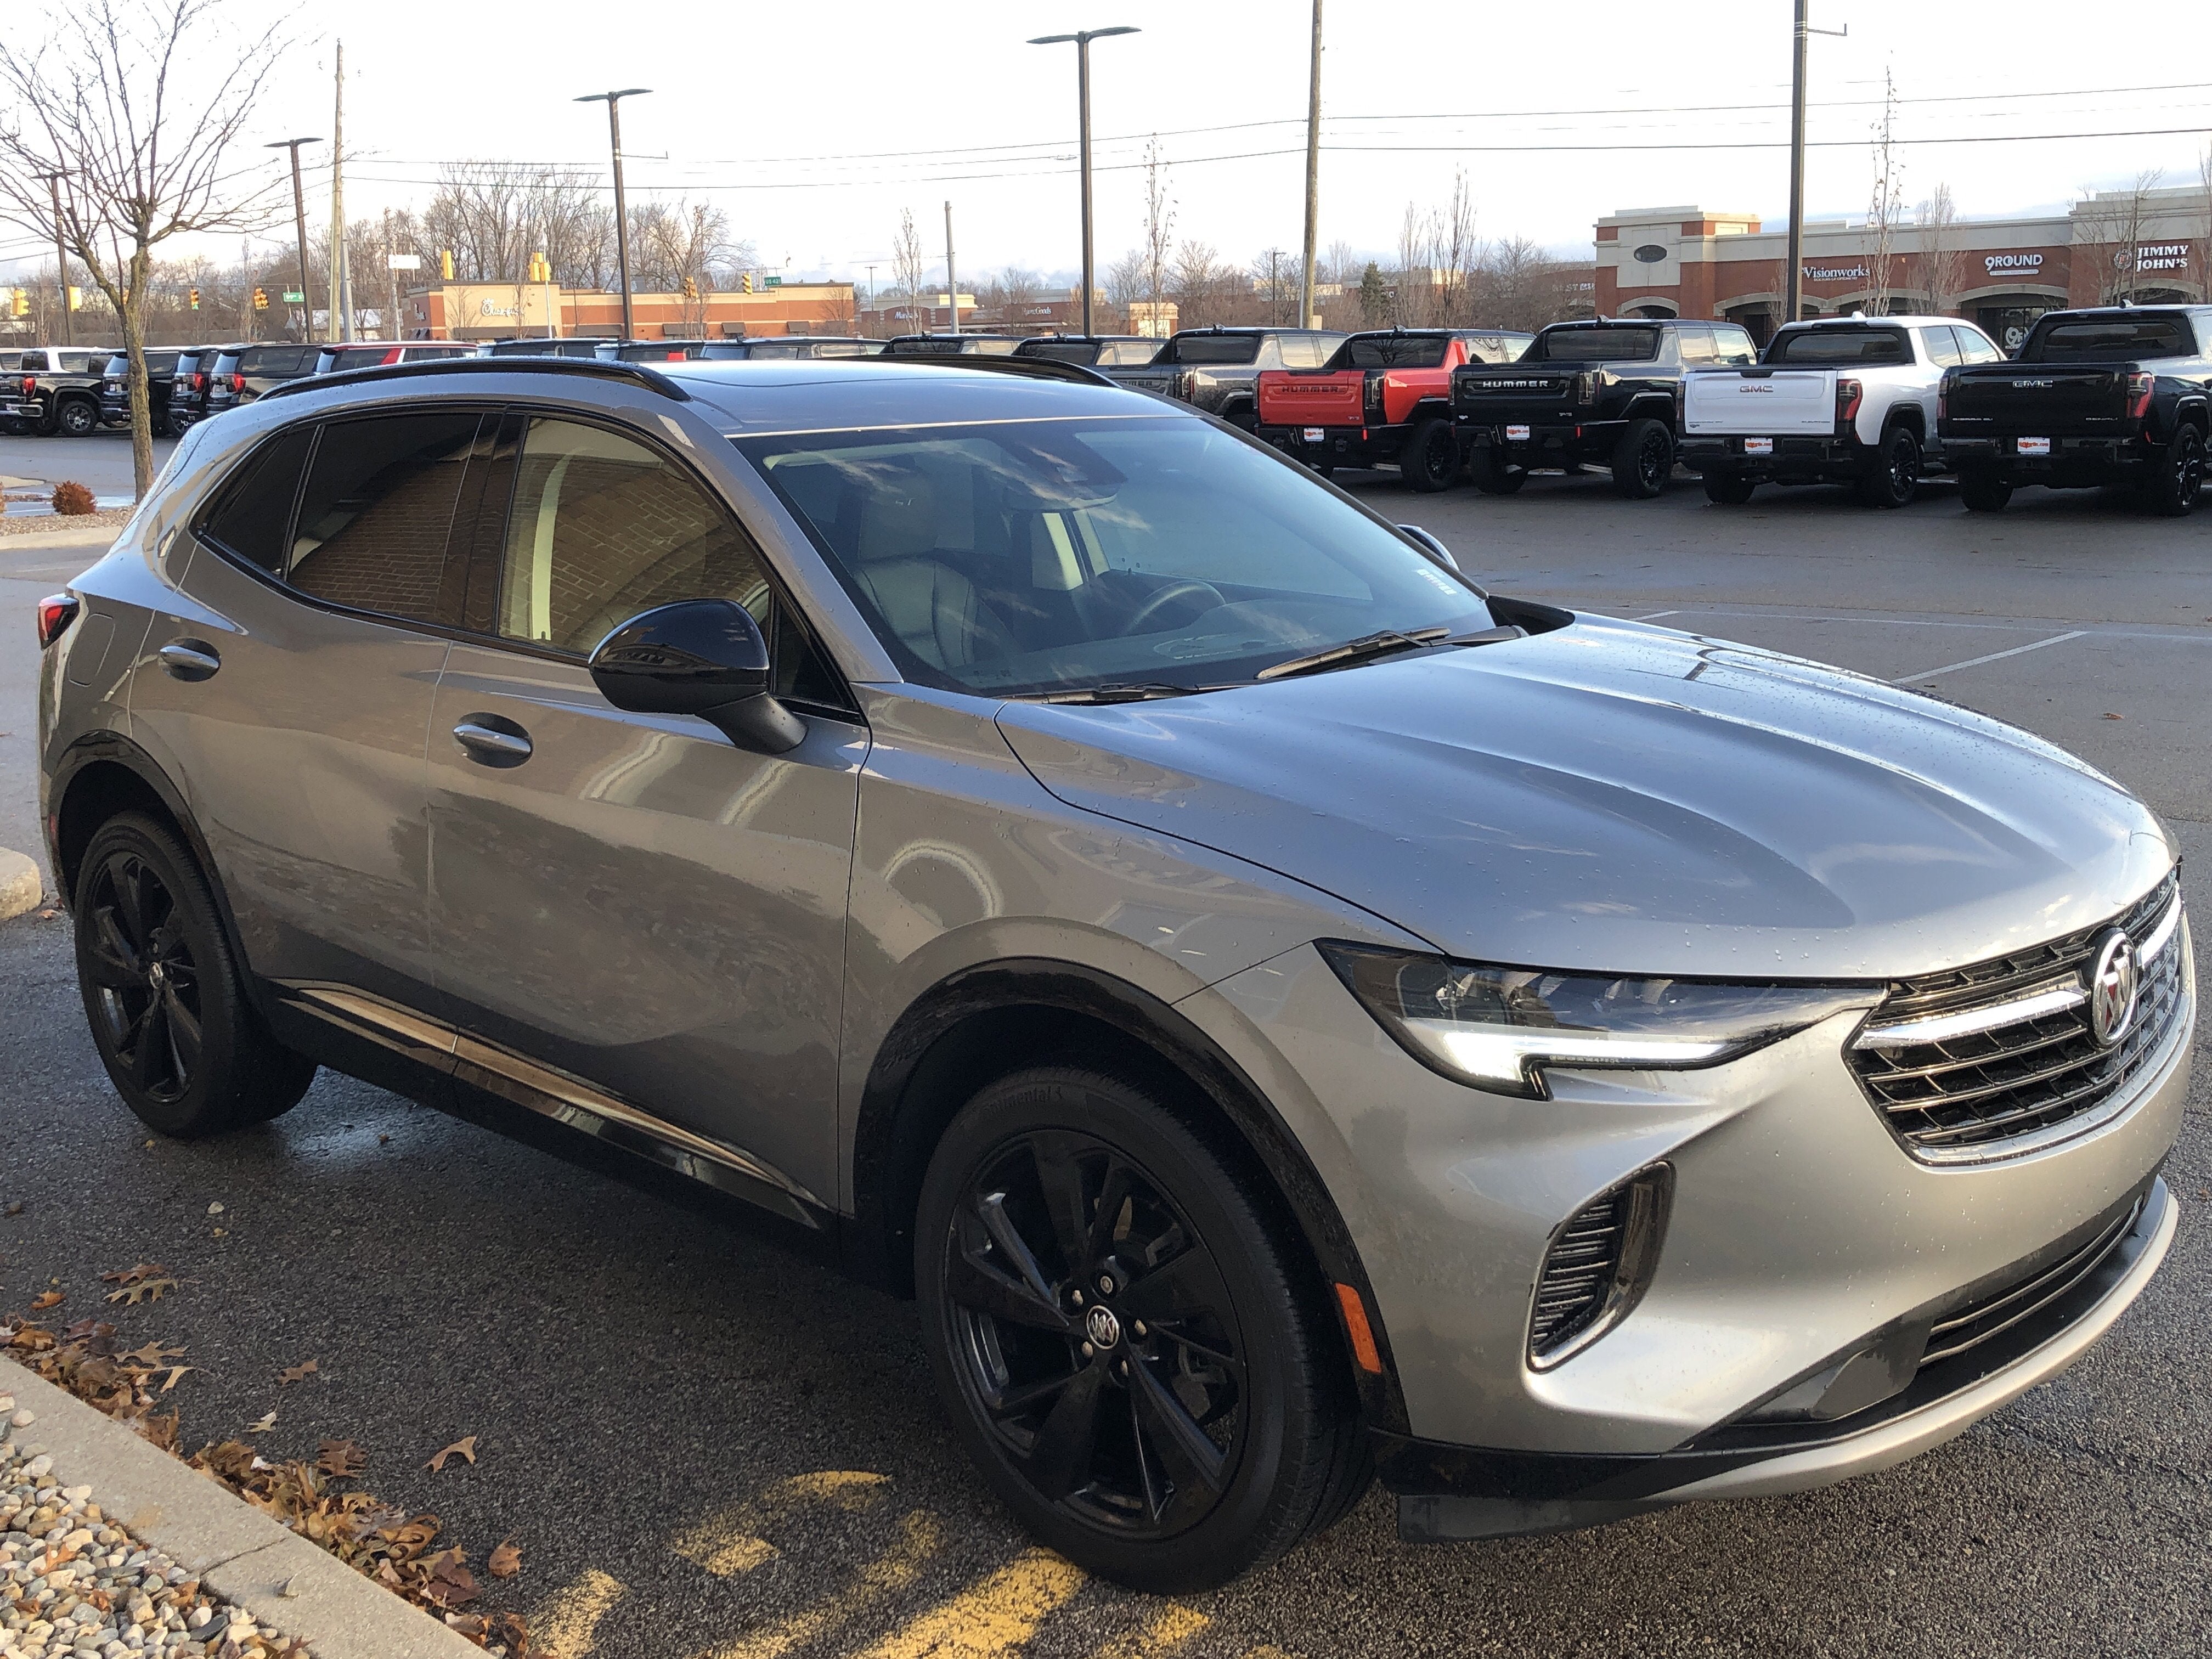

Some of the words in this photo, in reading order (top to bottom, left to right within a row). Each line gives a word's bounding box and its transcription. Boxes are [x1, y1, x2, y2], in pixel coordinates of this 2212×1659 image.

[2137, 245, 2188, 259] JIMMY
[1985, 254, 2043, 271] 9ROUND
[2136, 258, 2188, 272] JOHN'S
[1803, 264, 1870, 279] Visionworks
